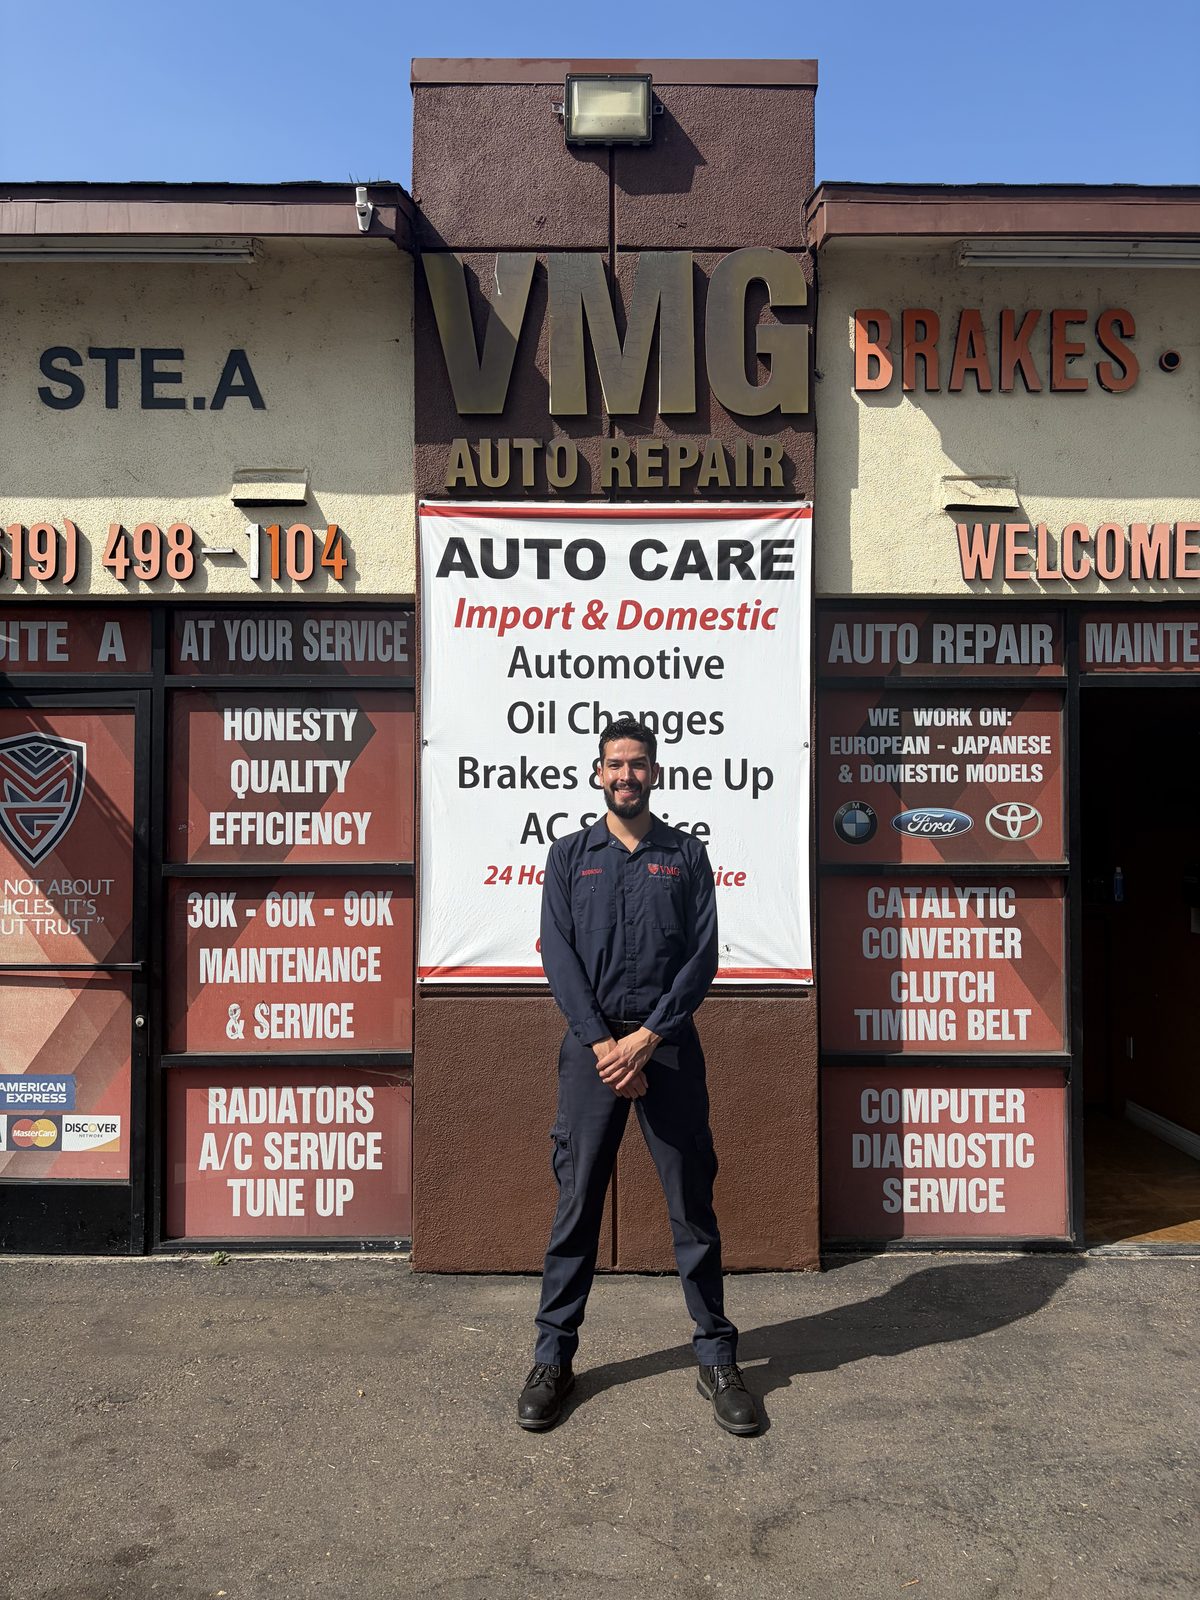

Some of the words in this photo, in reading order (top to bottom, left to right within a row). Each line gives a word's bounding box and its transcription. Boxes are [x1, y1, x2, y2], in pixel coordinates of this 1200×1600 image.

[421, 247, 809, 416] VMG
[855, 309, 1139, 392] BRAKES
[445, 438, 578, 488] AUTO
[601, 438, 785, 488] REPAIR
[0, 518, 76, 584] 19)
[435, 537, 606, 580] AUTO
[629, 538, 795, 581] CARE
[956, 522, 1200, 580] WELCOME
[454, 597, 575, 636] Import
[582, 599, 609, 631] &
[616, 599, 779, 631] Domestic
[98, 622, 126, 661] A
[180, 620, 215, 661] AT
[223, 619, 292, 661] YOUR
[302, 619, 408, 661] SERVICE
[828, 623, 919, 664] AUTO
[931, 623, 1053, 664] REPAIR
[1086, 623, 1200, 662] MAINTE
[508, 645, 725, 680] Automotive
[223, 708, 358, 741] HONESTY
[507, 700, 555, 734] Oil
[868, 708, 900, 727] WE
[913, 708, 972, 727] WORK
[979, 708, 1012, 727] ON:
[830, 736, 930, 755] EUROPEAN
[952, 736, 1051, 755] JAPANESE
[230, 760, 351, 799] QUALITY
[458, 756, 578, 790] Brakes
[724, 758, 774, 799] Up
[838, 764, 853, 783] &
[860, 764, 959, 783] DOMESTIC
[966, 764, 1043, 783] MODELS
[839, 802, 874, 815] BMW
[907, 813, 956, 832] Ford
[209, 811, 372, 845] EFFICIENCY
[520, 812, 568, 844] AC
[4, 879, 44, 895] NOT
[47, 879, 115, 895] ABOUT
[484, 865, 512, 885] 24
[64, 899, 96, 915] IT'S
[188, 892, 236, 928] 30K
[266, 891, 315, 927] 60K
[344, 890, 393, 927] 90K
[867, 887, 1016, 919] CATALYTIC
[862, 927, 1022, 959] CONVERTER
[200, 946, 381, 984] MAINTENANCE
[891, 971, 995, 1003] CLUTCH
[226, 1003, 244, 1039] &
[254, 1003, 354, 1039] SERVICE
[854, 1009, 957, 1041] TIMING
[967, 1009, 1032, 1041] BELT
[6, 1094, 67, 1103] EXPRESS
[208, 1086, 374, 1124] RADIATORS
[860, 1088, 1025, 1124] COMPUTER
[12, 1129, 56, 1137] MasterCard
[65, 1123, 117, 1132] DISCOVER
[199, 1132, 252, 1171] A/C
[264, 1132, 383, 1170] SERVICE
[852, 1133, 1035, 1168] DIAGNOSTIC
[227, 1179, 303, 1217] TUNE
[315, 1179, 354, 1217] UP
[882, 1178, 1005, 1213] SERVICE
